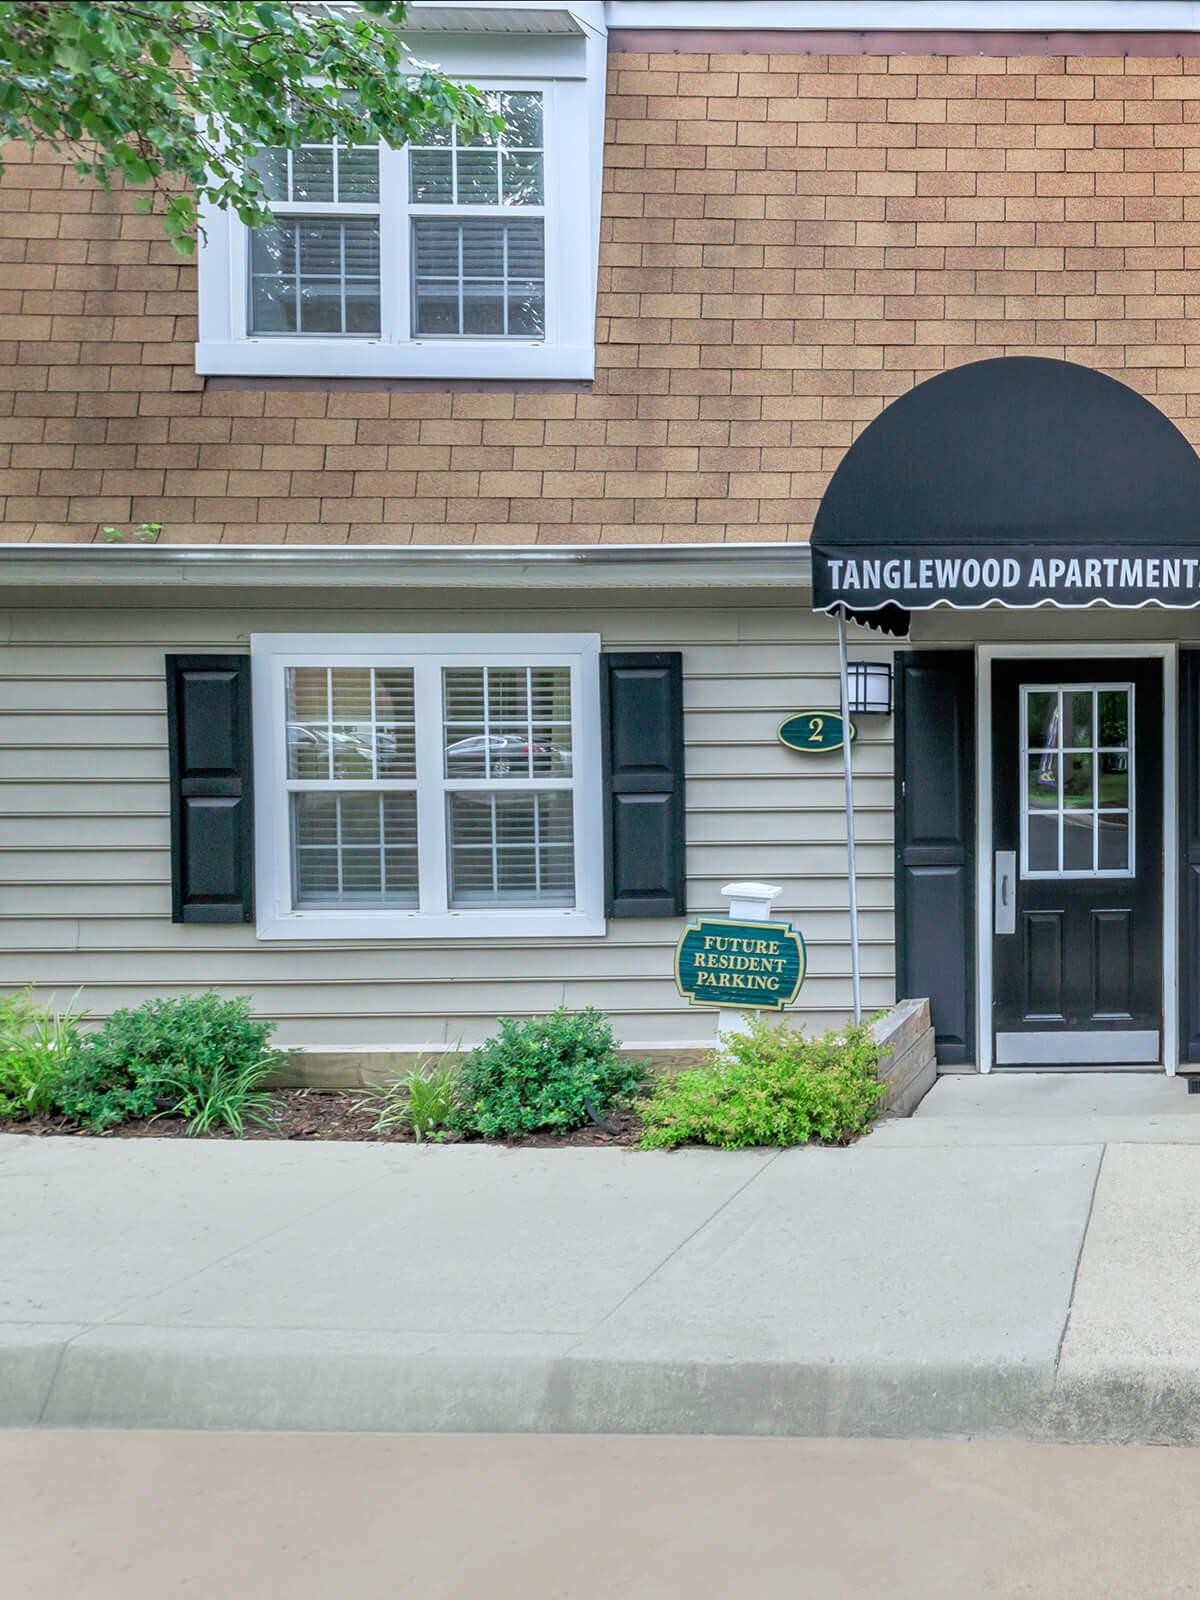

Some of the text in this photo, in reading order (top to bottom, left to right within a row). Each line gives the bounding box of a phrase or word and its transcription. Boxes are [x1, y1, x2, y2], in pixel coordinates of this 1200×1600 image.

[827, 558, 1021, 590] TANGLEWOOD
[808, 718, 823, 742] 2
[703, 935, 780, 955] FUTURE
[693, 952, 787, 973] RESIDENT
[695, 971, 780, 991] PARKING
